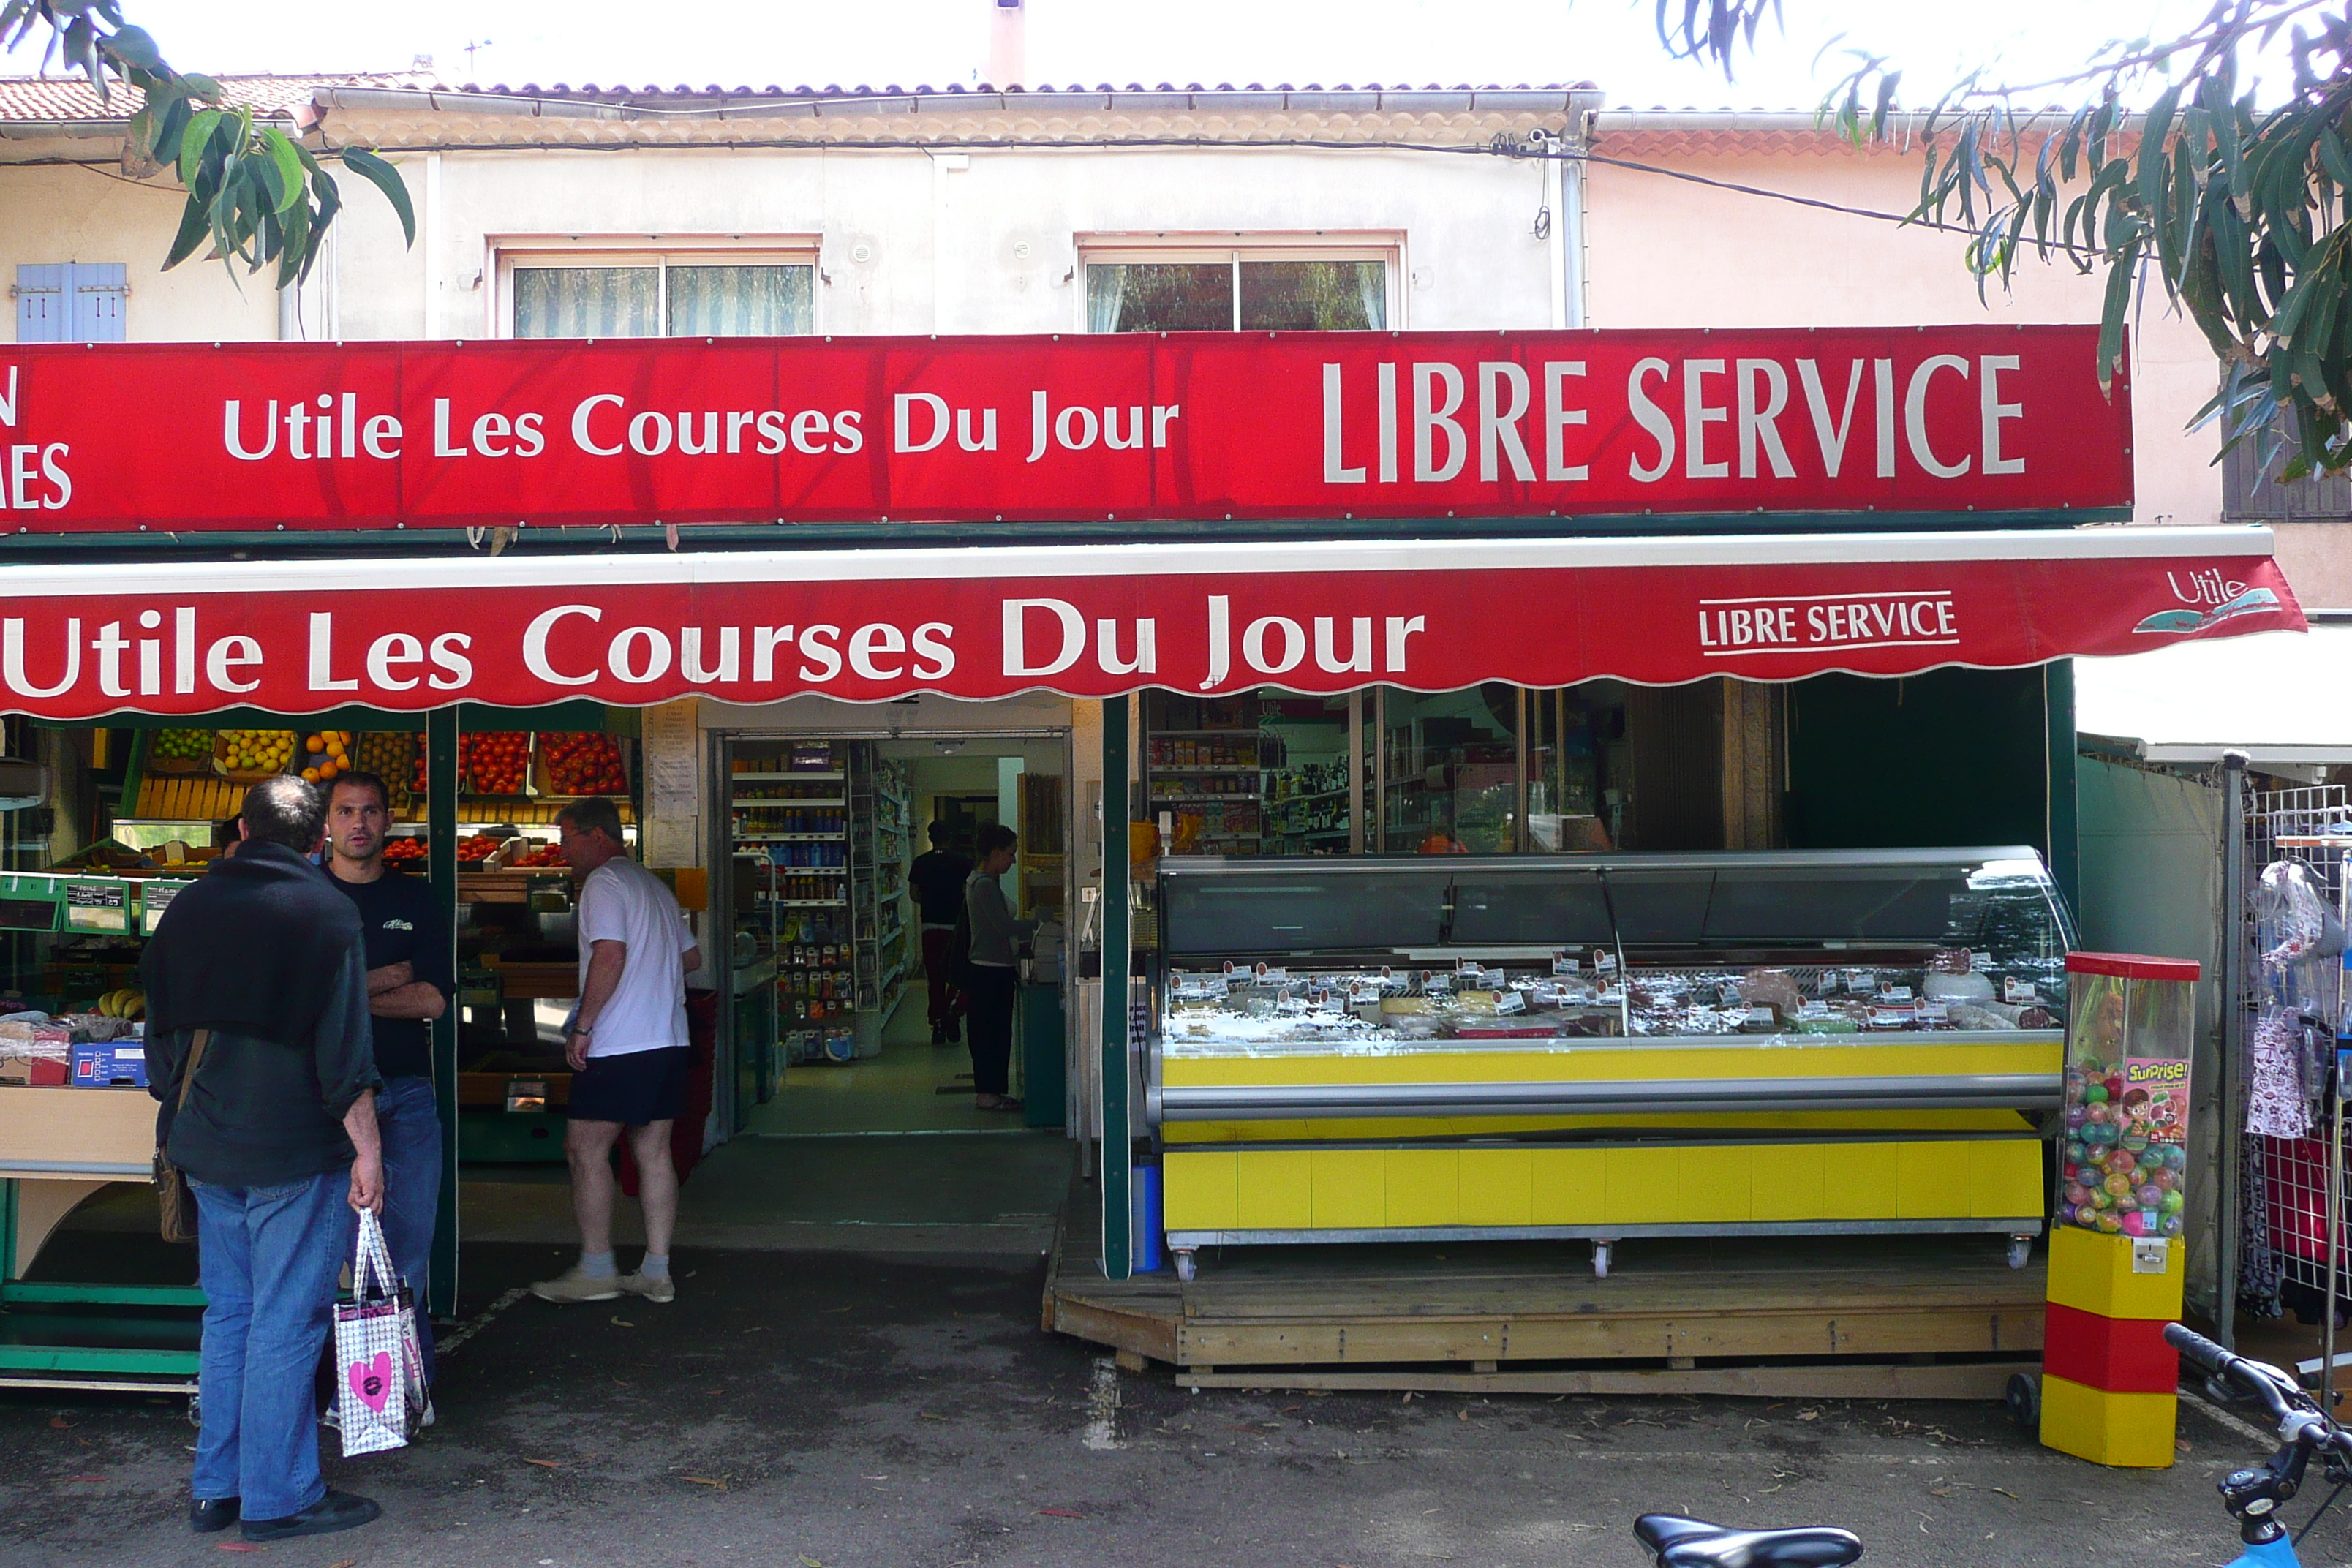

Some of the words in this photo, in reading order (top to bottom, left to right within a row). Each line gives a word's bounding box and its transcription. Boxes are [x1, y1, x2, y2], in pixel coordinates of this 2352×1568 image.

[225, 392, 402, 460] Utile
[434, 398, 545, 457] Les
[571, 394, 863, 456] Courses
[894, 393, 997, 453] Du
[1025, 390, 1180, 462] Jour
[1323, 361, 1588, 483] LIBRE
[1628, 355, 2025, 483] SERVICE
[0, 442, 72, 510] ES
[2166, 568, 2250, 605] Utile
[2, 606, 264, 698] Utile
[308, 611, 473, 692] Les
[522, 604, 956, 686] Courses
[1002, 598, 1156, 676] Du
[1199, 594, 1425, 690] Jour
[1699, 607, 1798, 646] LIBRE
[1808, 600, 1958, 643] SERVICE
[1262, 700, 1282, 715] Utile
[2128, 1063, 2189, 1082] Surprise!
